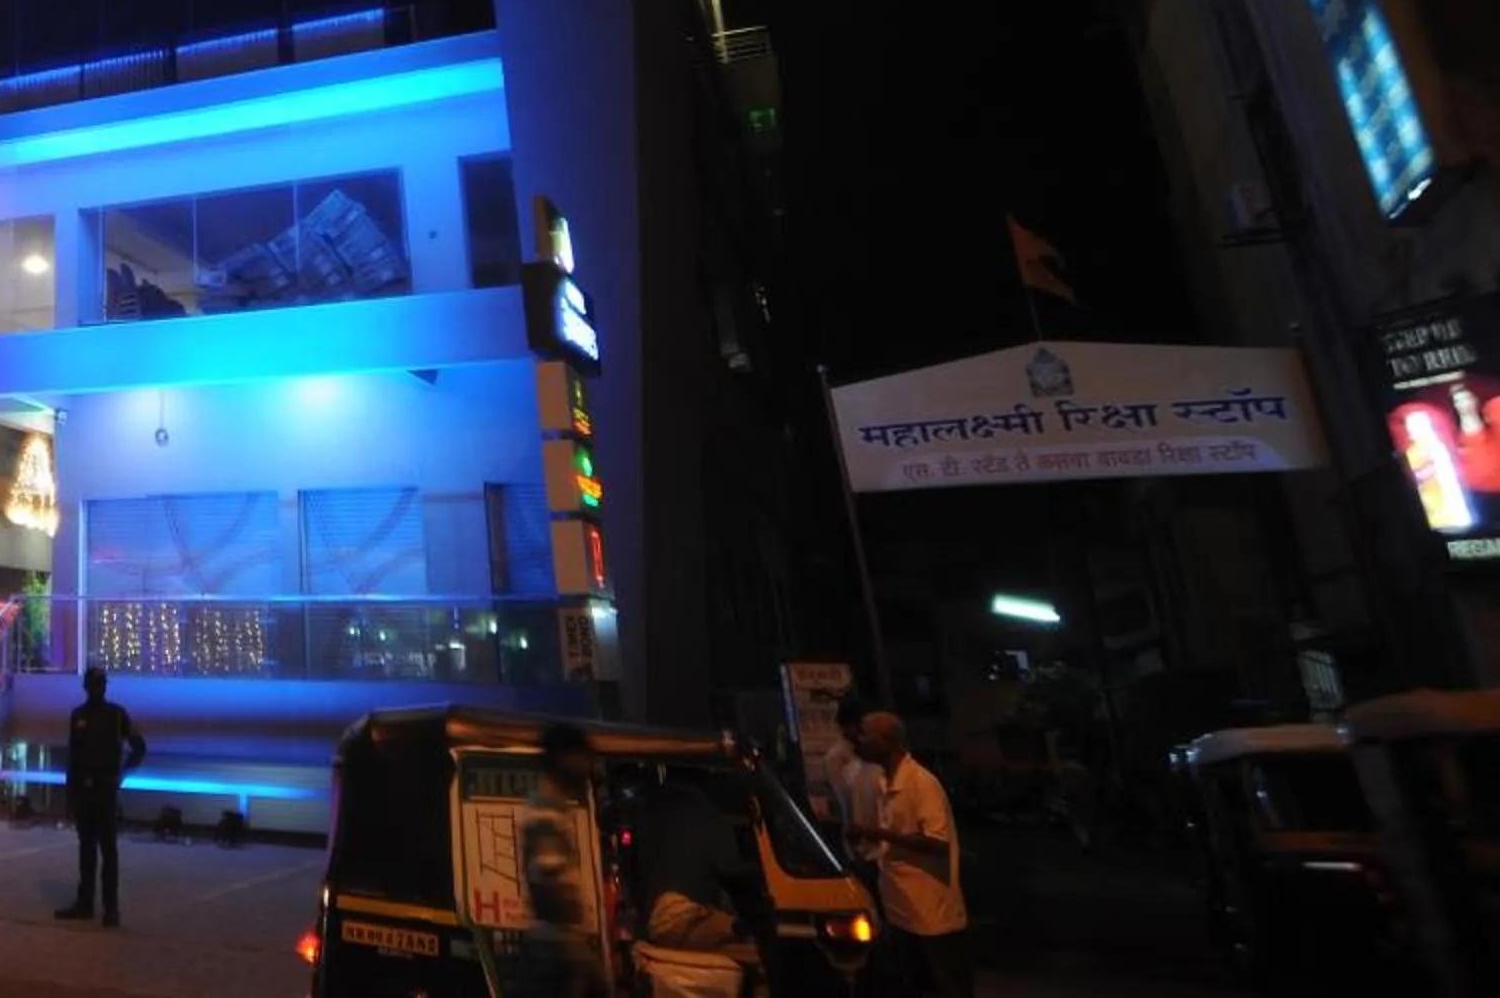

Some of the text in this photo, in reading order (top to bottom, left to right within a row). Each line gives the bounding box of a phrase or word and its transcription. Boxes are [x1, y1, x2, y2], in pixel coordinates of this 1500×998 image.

[859, 387, 1288, 448] महालक्ष्मी रिक्षा स्टॉप
